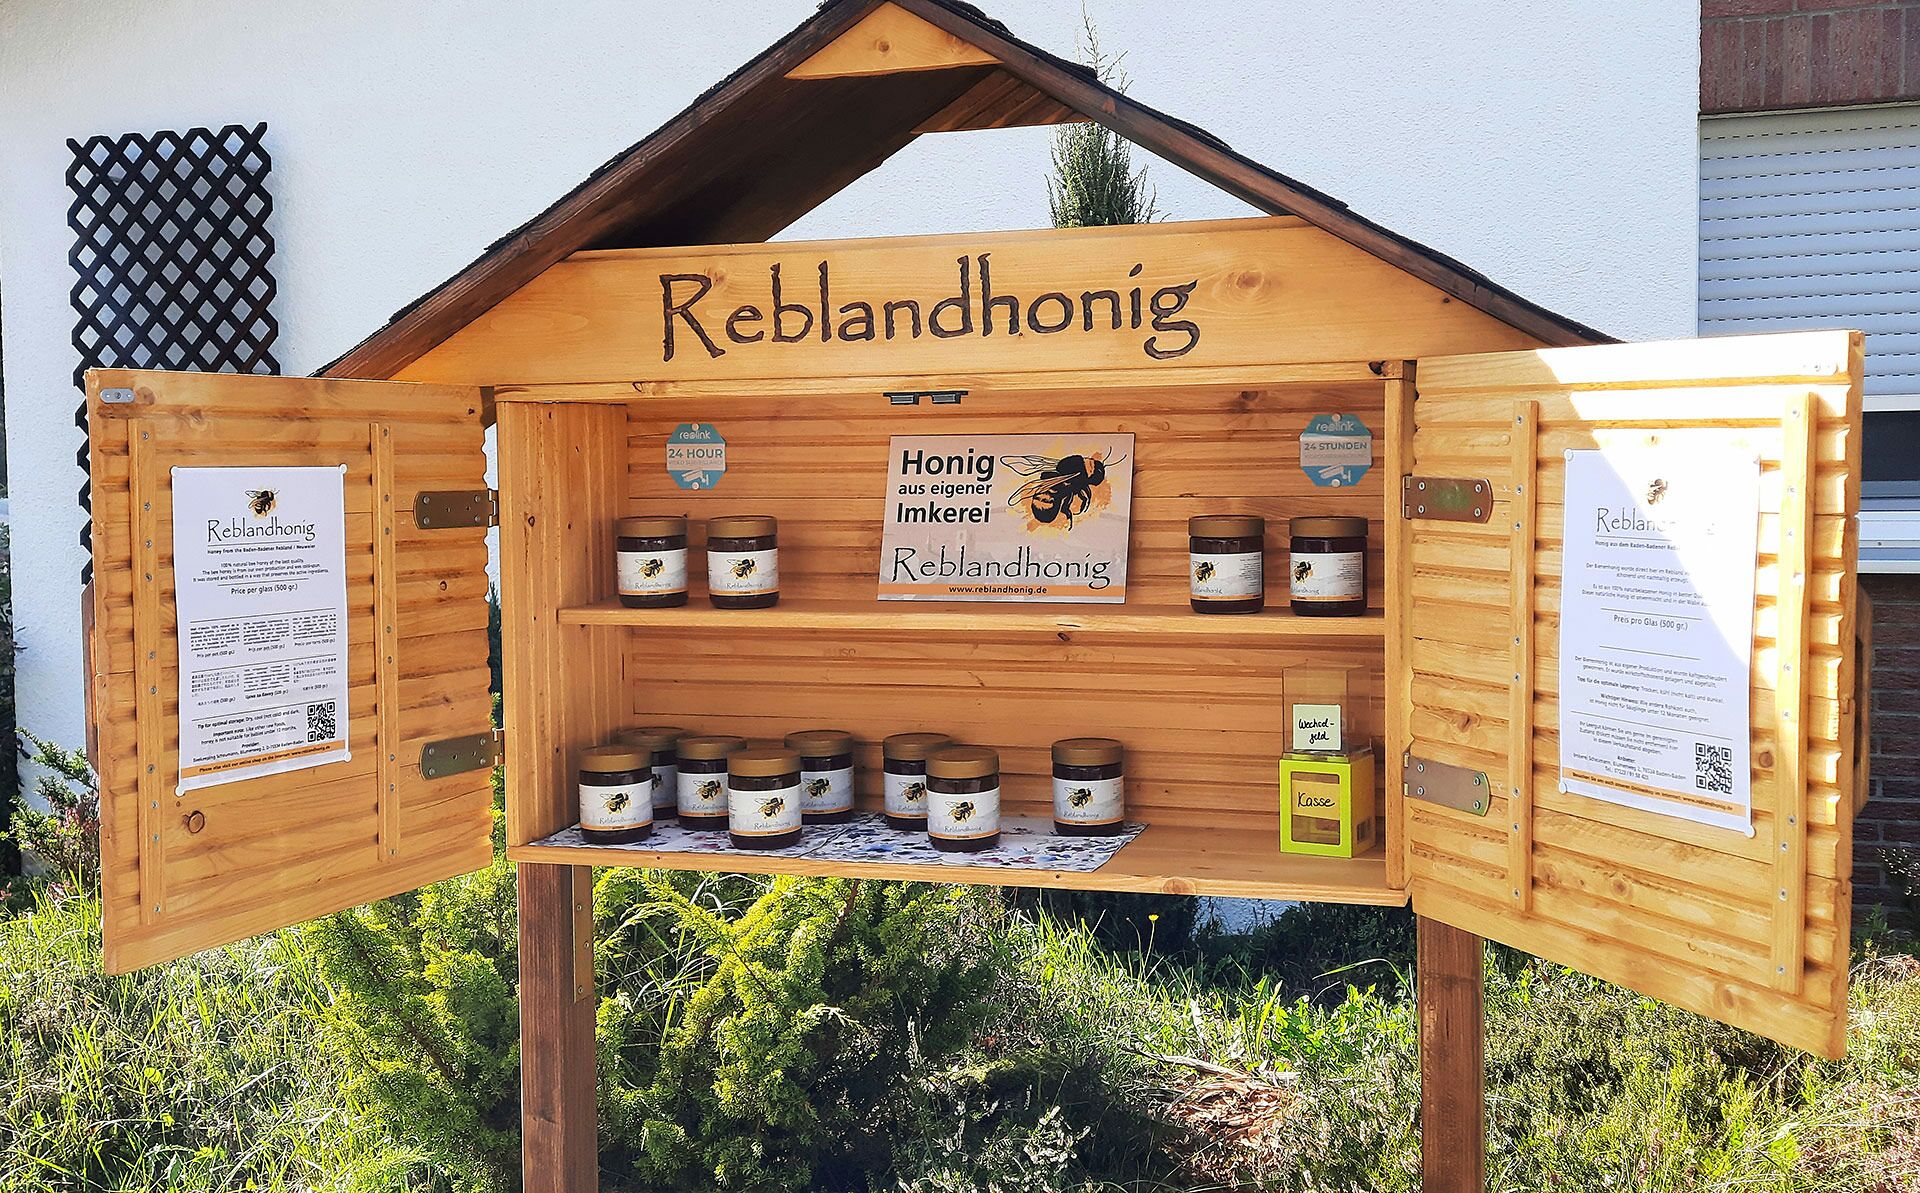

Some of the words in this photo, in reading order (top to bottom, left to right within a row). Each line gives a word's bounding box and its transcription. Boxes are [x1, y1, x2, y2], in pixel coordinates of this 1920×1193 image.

[660, 252, 1198, 362] Reblandhonig
[680, 430, 711, 440] reolink
[668, 449, 684, 459] 24
[687, 449, 723, 459] HOUR
[1304, 443, 1317, 451] 24
[1319, 442, 1367, 451] STUNDEN
[901, 447, 996, 482] Honig
[898, 484, 926, 495] aus
[931, 482, 993, 499] eigener
[896, 501, 990, 523] Imkerei
[207, 516, 316, 543] Reblandhonig
[892, 545, 1112, 590] Reblandhonig
[231, 587, 245, 595] Price
[247, 587, 257, 595] per
[259, 585, 273, 594] glass
[949, 585, 1048, 596] www.reblandhonig.de
[1614, 614, 1629, 623] Preis
[1631, 618, 1642, 626] pro
[1644, 617, 1658, 627] Glas
[1309, 731, 1330, 745] geld
[1298, 792, 1336, 809] Kasse
